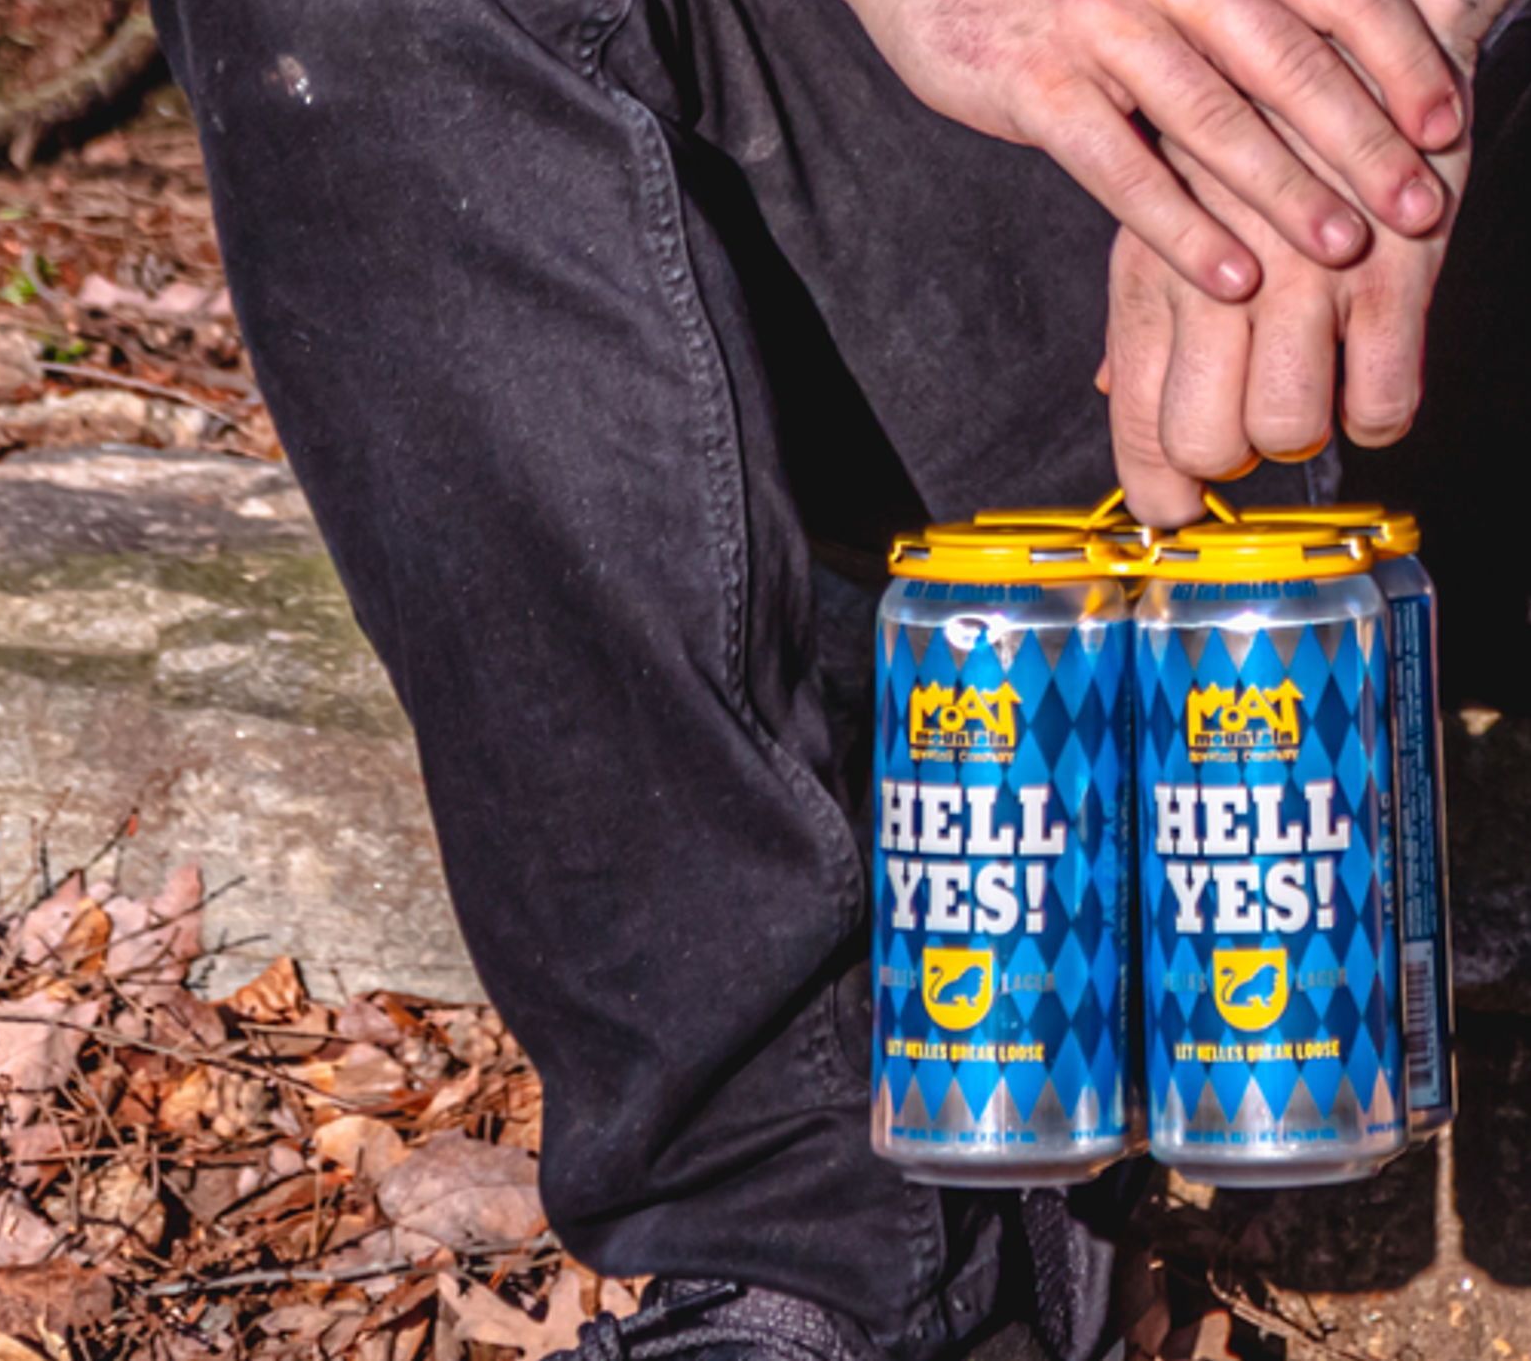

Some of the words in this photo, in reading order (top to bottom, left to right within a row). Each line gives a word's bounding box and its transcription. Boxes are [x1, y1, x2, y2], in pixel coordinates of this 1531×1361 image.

[909, 679, 1023, 747] MOAT
[1187, 676, 1304, 747] MOAT
[880, 781, 1066, 855] HELL
[1155, 781, 1351, 855] HELL
[887, 857, 1046, 934] YES!
[1166, 858, 1336, 934] YES!
